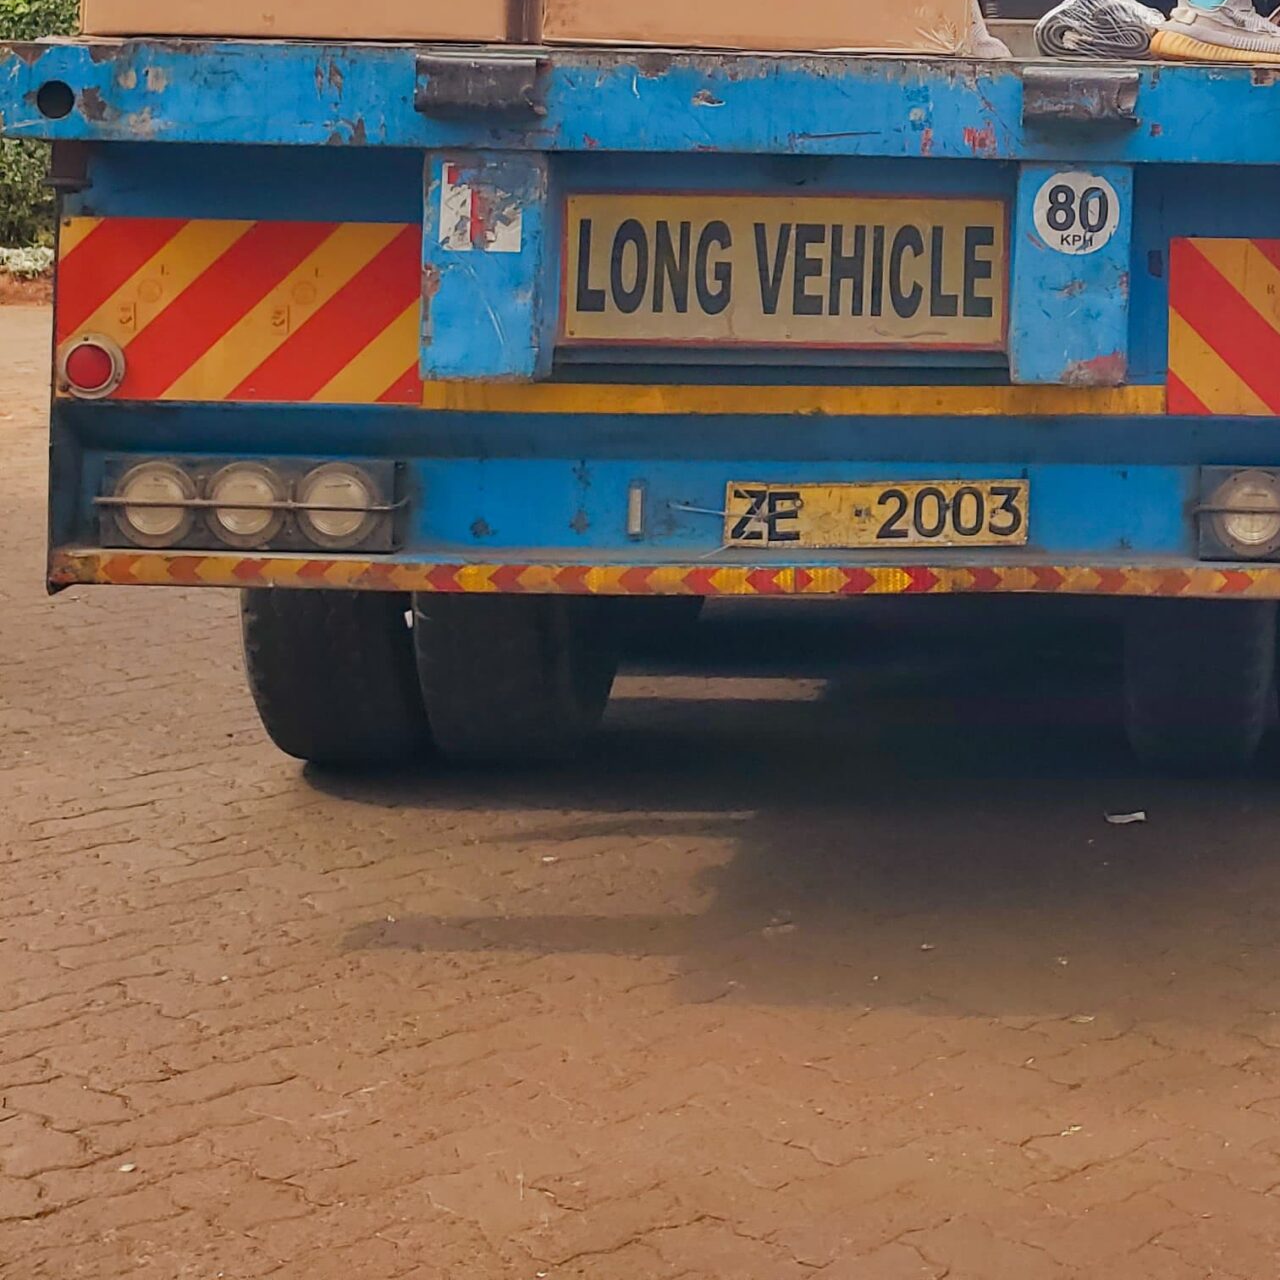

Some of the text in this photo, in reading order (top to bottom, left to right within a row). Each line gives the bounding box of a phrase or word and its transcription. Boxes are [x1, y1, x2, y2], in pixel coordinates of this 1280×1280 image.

[1046, 184, 1109, 233] 80
[1060, 234, 1094, 247] KPH
[575, 218, 995, 319] LONG VEHICLE
[730, 485, 1022, 542] ZE 2003
